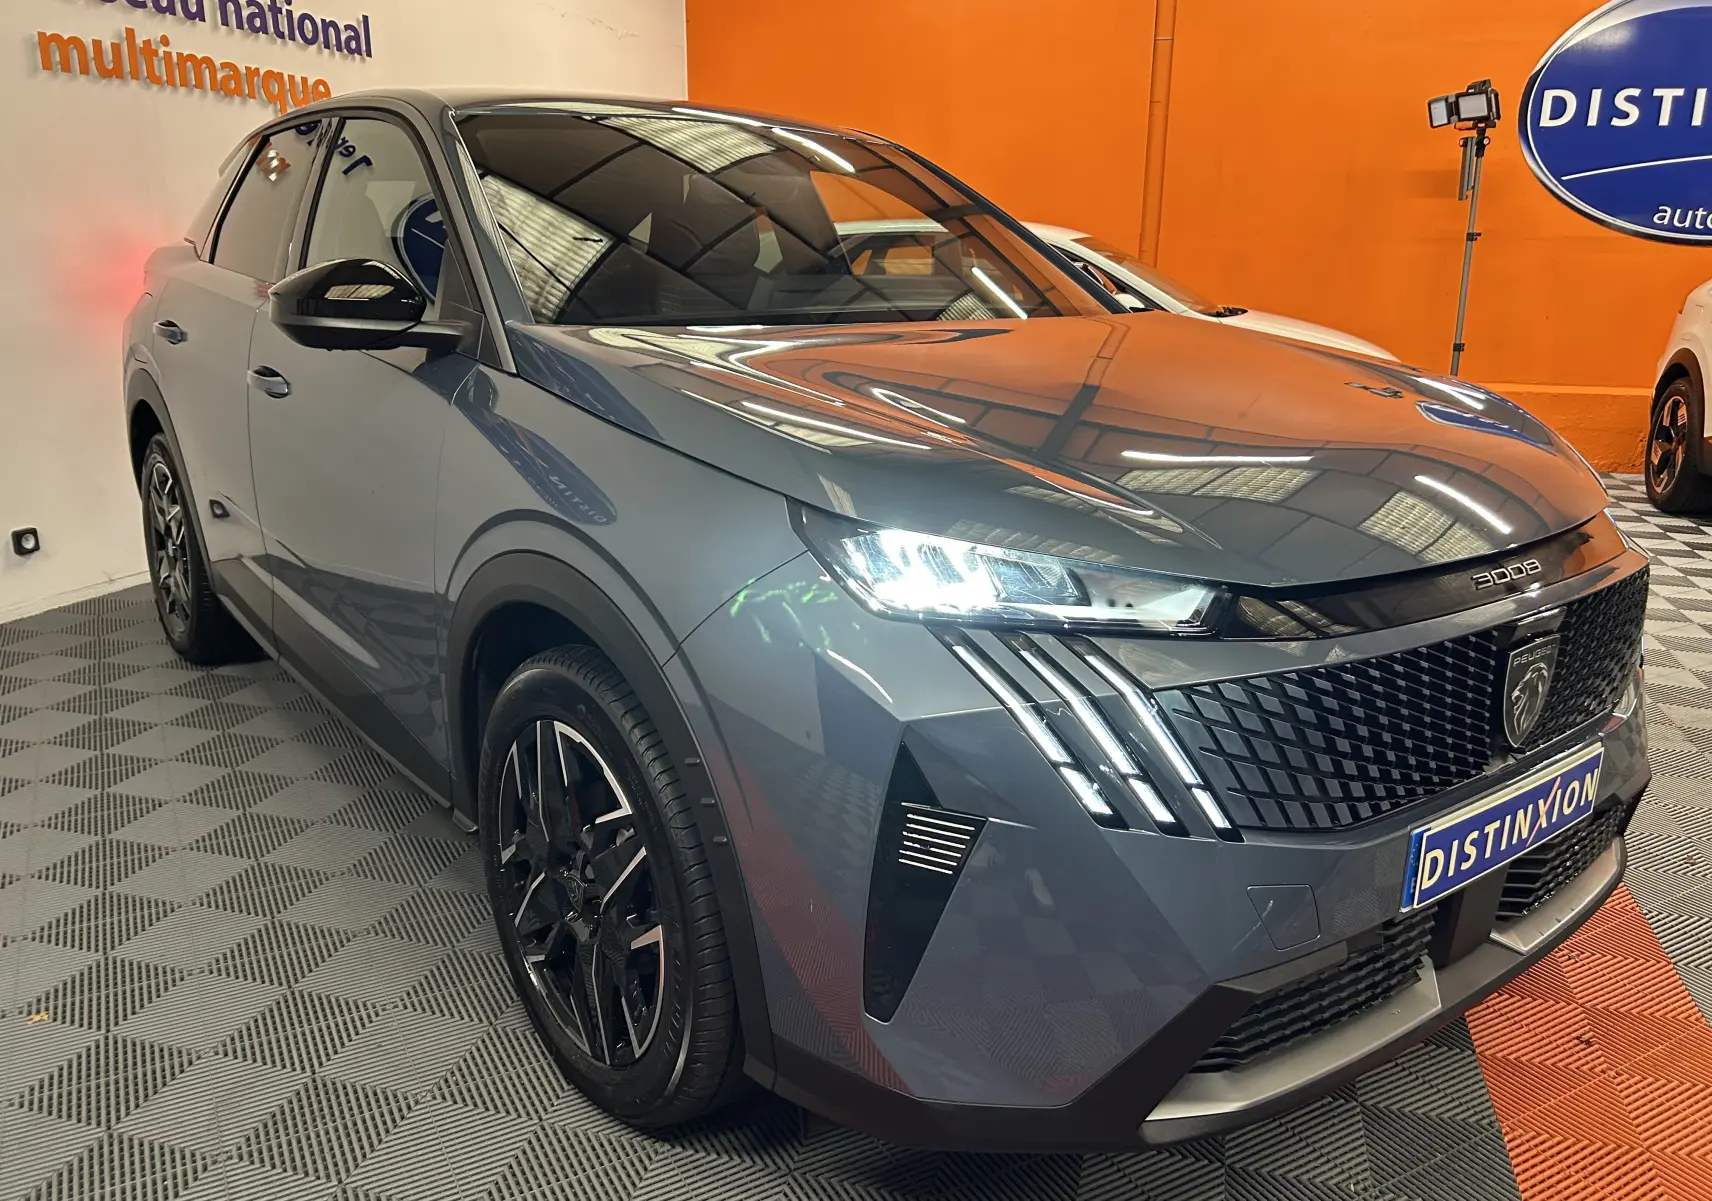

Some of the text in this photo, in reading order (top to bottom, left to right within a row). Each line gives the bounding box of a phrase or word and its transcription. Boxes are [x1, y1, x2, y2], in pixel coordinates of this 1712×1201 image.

[218, 0, 373, 59] national
[37, 27, 332, 116] multimarque
[1539, 88, 1708, 127] DISTI
[1472, 559, 1542, 590] 3008
[1513, 644, 1556, 667] PEUGEOT
[1421, 768, 1599, 890] DISTINXION
